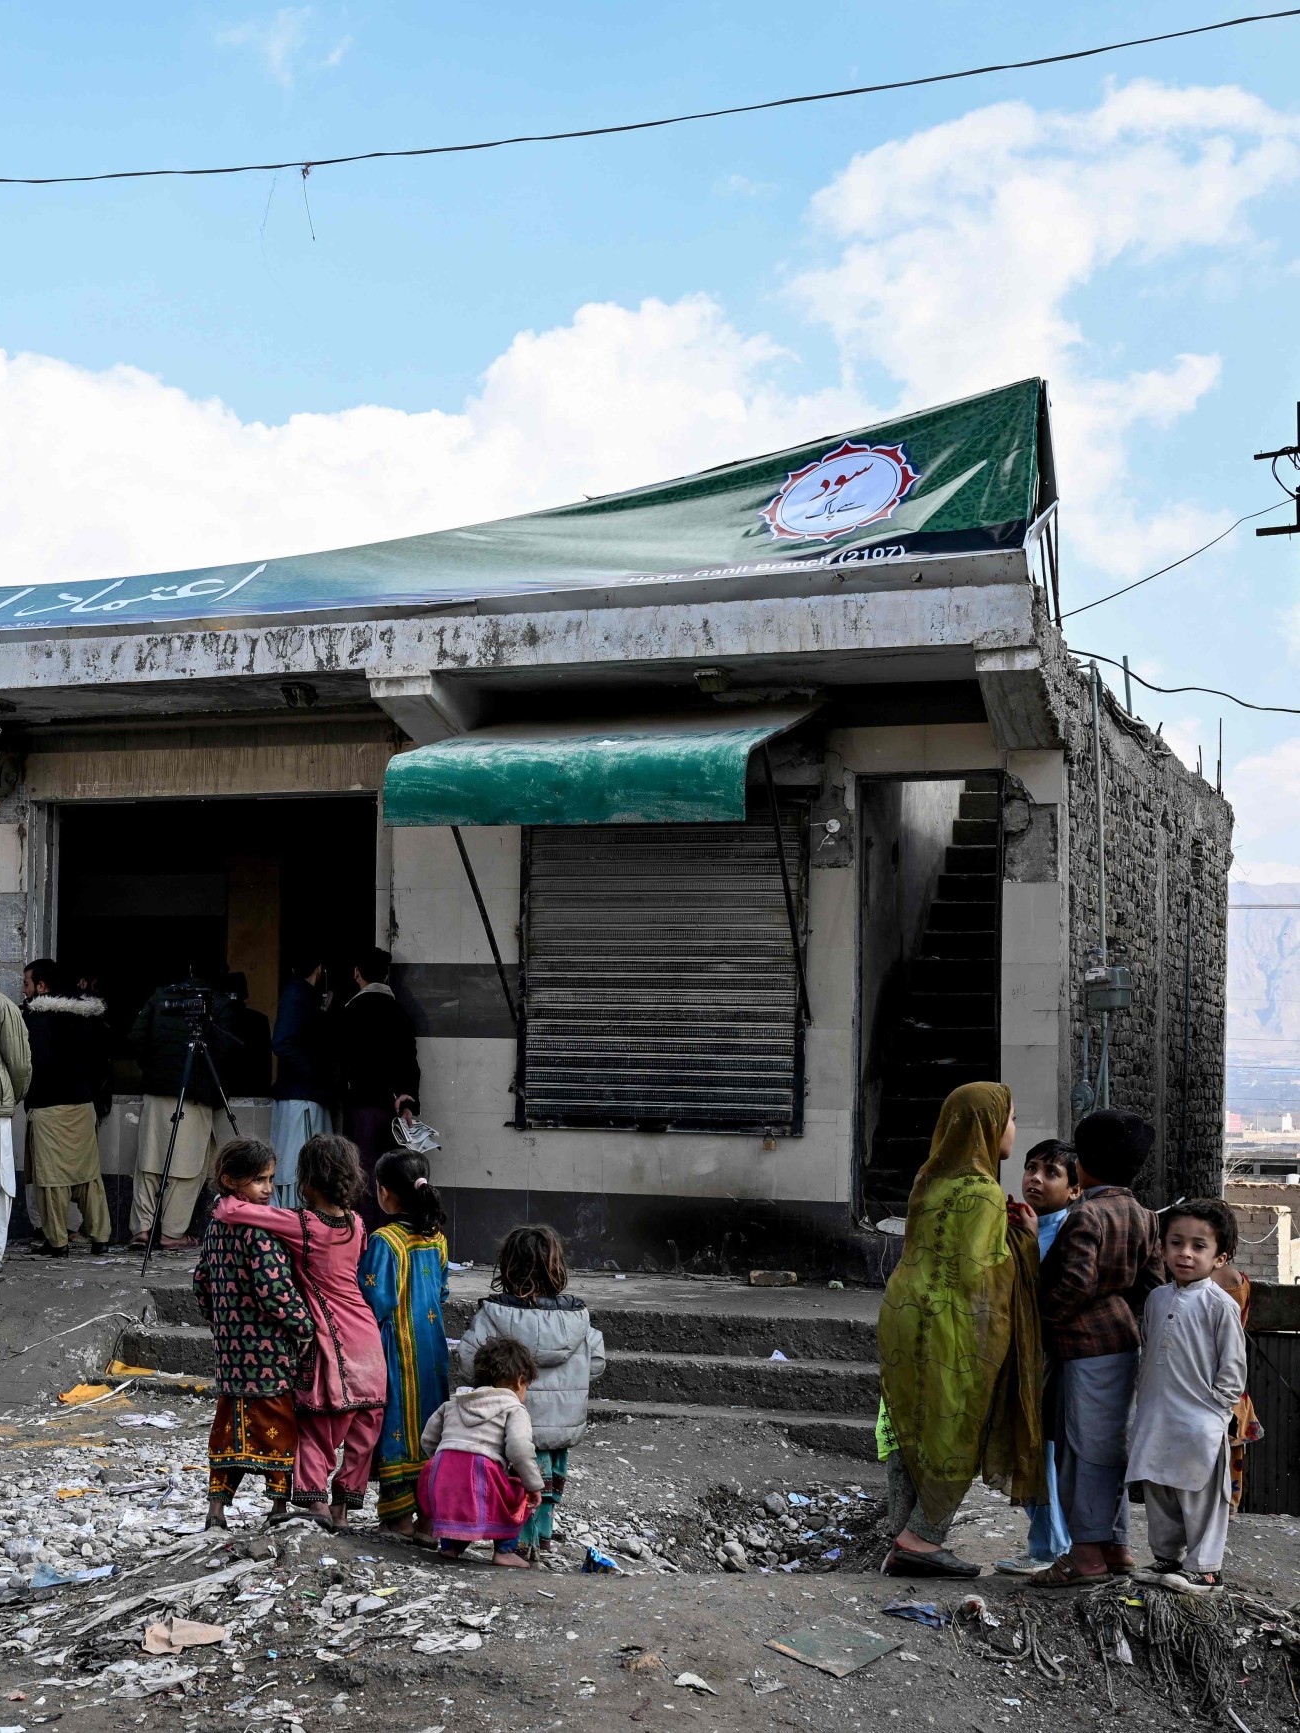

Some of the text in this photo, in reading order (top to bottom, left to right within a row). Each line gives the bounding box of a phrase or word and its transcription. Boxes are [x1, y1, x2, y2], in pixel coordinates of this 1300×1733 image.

[808, 462, 874, 502] سود
[805, 496, 839, 521] پاک
[628, 545, 906, 583] Hazar Ganji Branch (2107)
[13, 562, 268, 618] اعتماد
